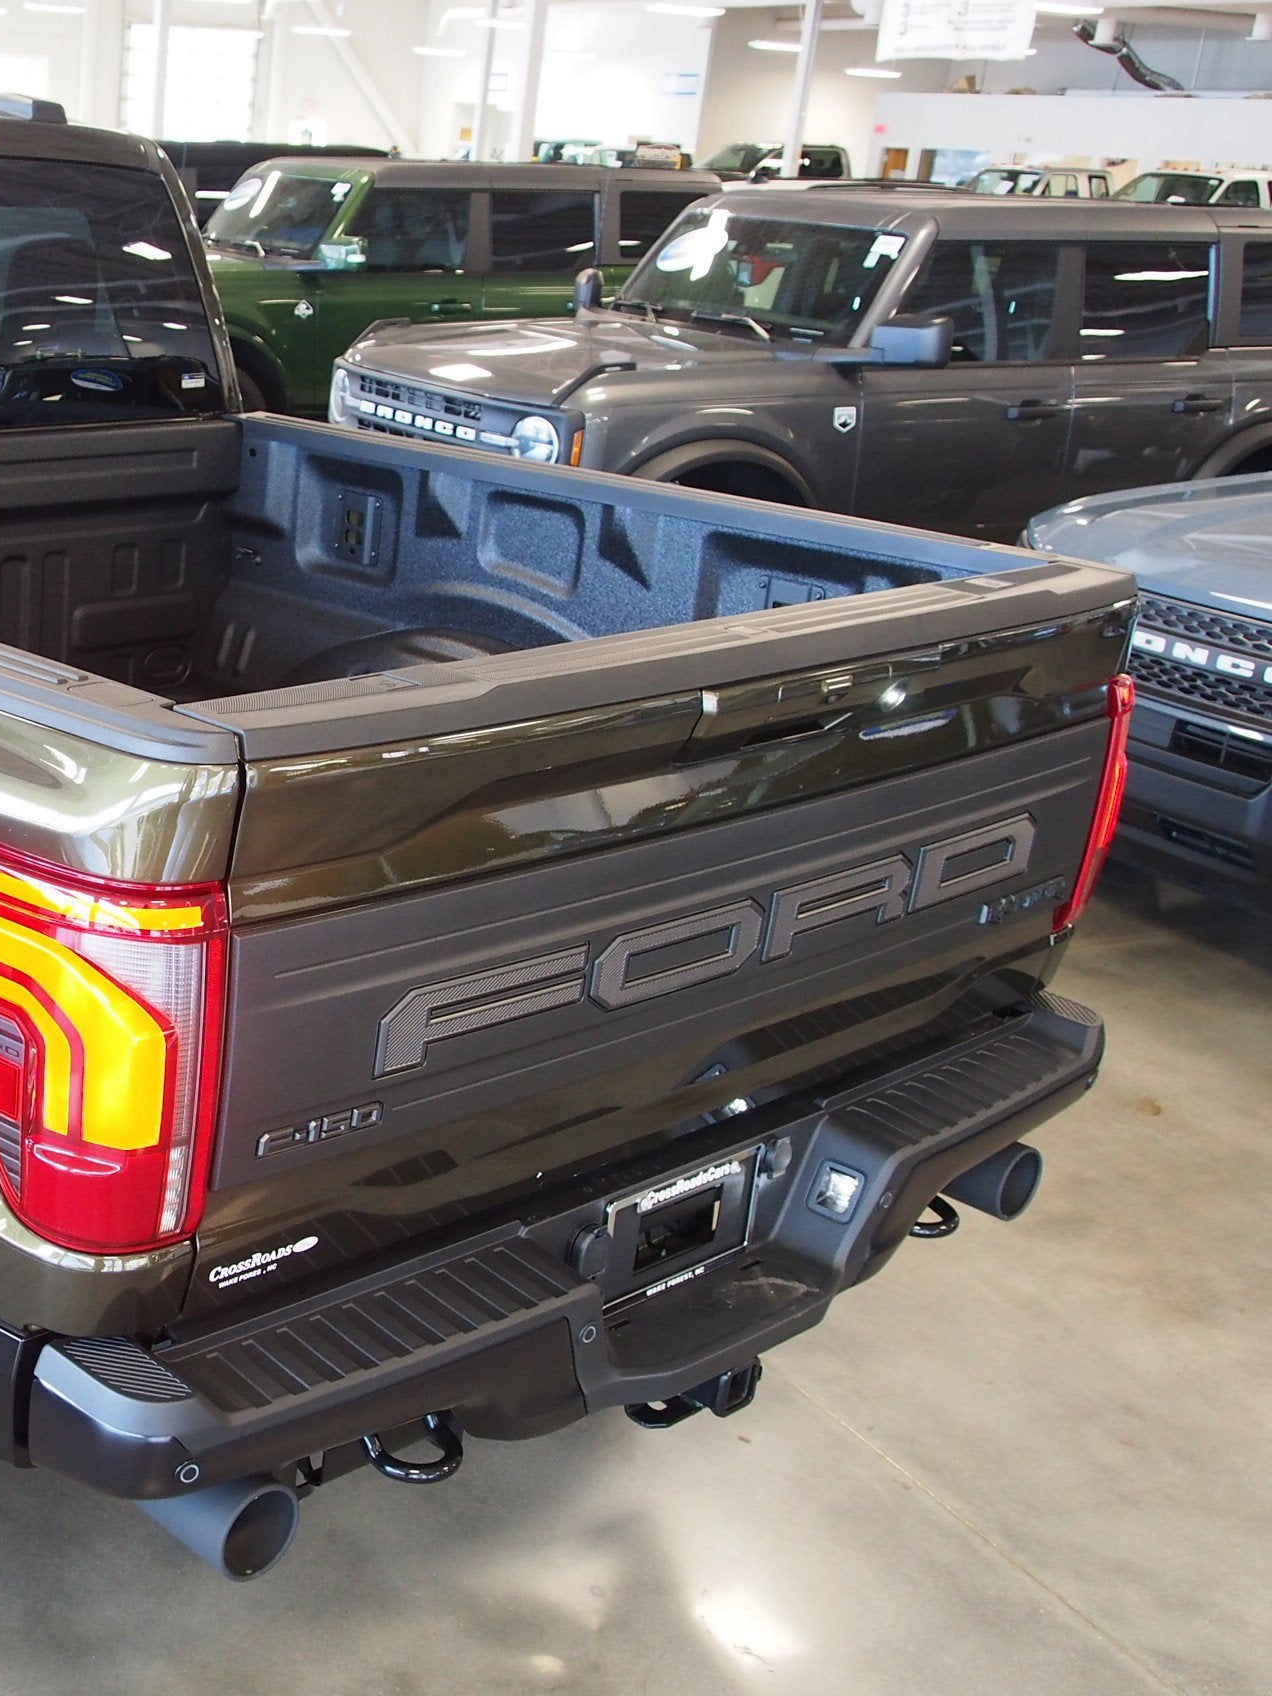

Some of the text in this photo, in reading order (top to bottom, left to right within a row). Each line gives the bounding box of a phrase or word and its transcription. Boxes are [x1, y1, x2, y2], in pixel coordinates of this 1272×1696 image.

[359, 400, 476, 441] BRONCO
[1132, 631, 1272, 684] ONC
[372, 812, 1037, 1080] FORD
[256, 1101, 384, 1159] F-150
[218, 1276, 239, 1289] WAKE
[646, 1283, 666, 1297] WAKE
